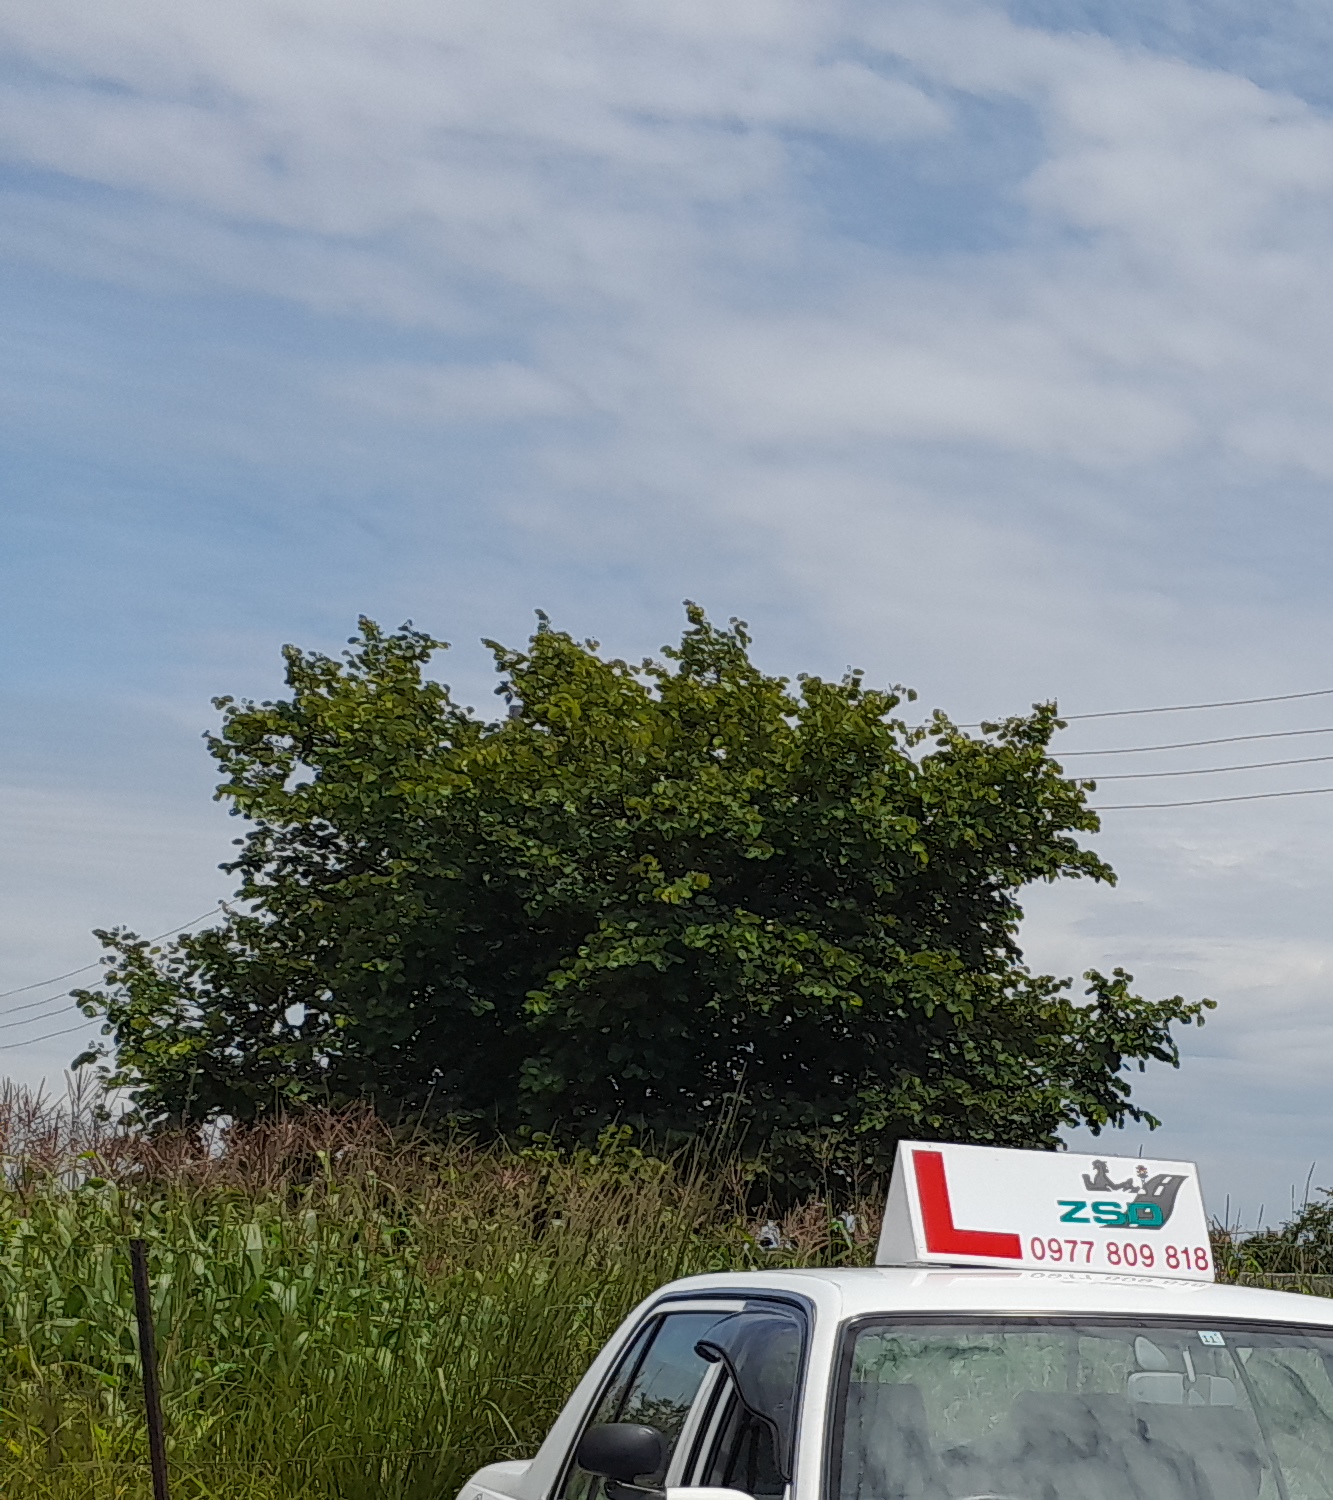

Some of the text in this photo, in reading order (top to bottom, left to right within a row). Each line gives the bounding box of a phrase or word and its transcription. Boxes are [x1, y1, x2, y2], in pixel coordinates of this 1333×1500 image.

[912, 1149, 1023, 1260] L
[1030, 1236, 1209, 1271] 0977 809 818
